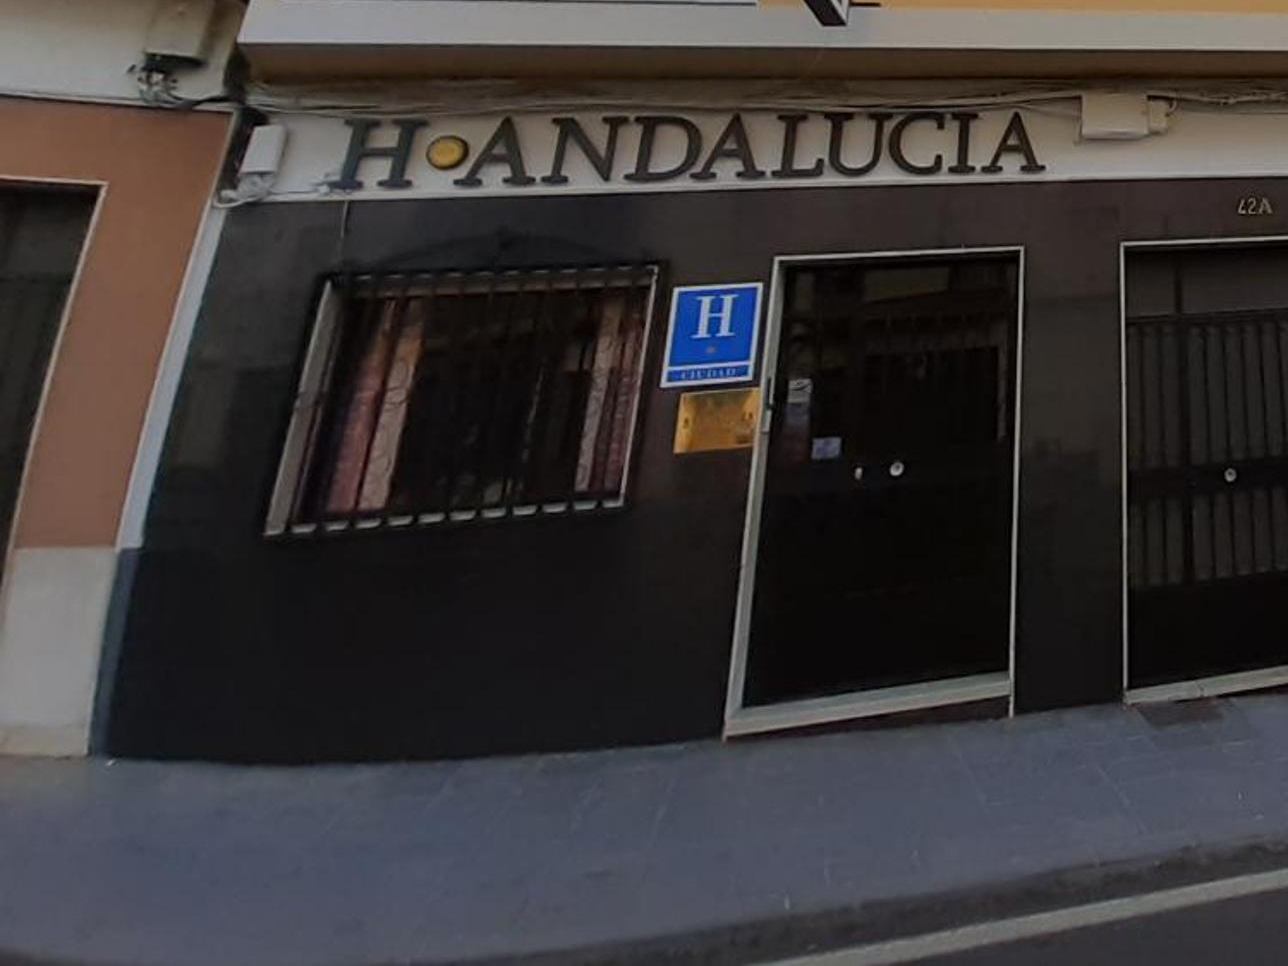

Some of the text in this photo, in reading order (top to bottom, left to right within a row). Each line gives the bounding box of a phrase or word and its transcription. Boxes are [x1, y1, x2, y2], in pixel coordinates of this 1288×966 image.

[453, 110, 1046, 187] ANDALUCIA
[1237, 196, 1273, 215] 42A
[691, 293, 740, 340] H
